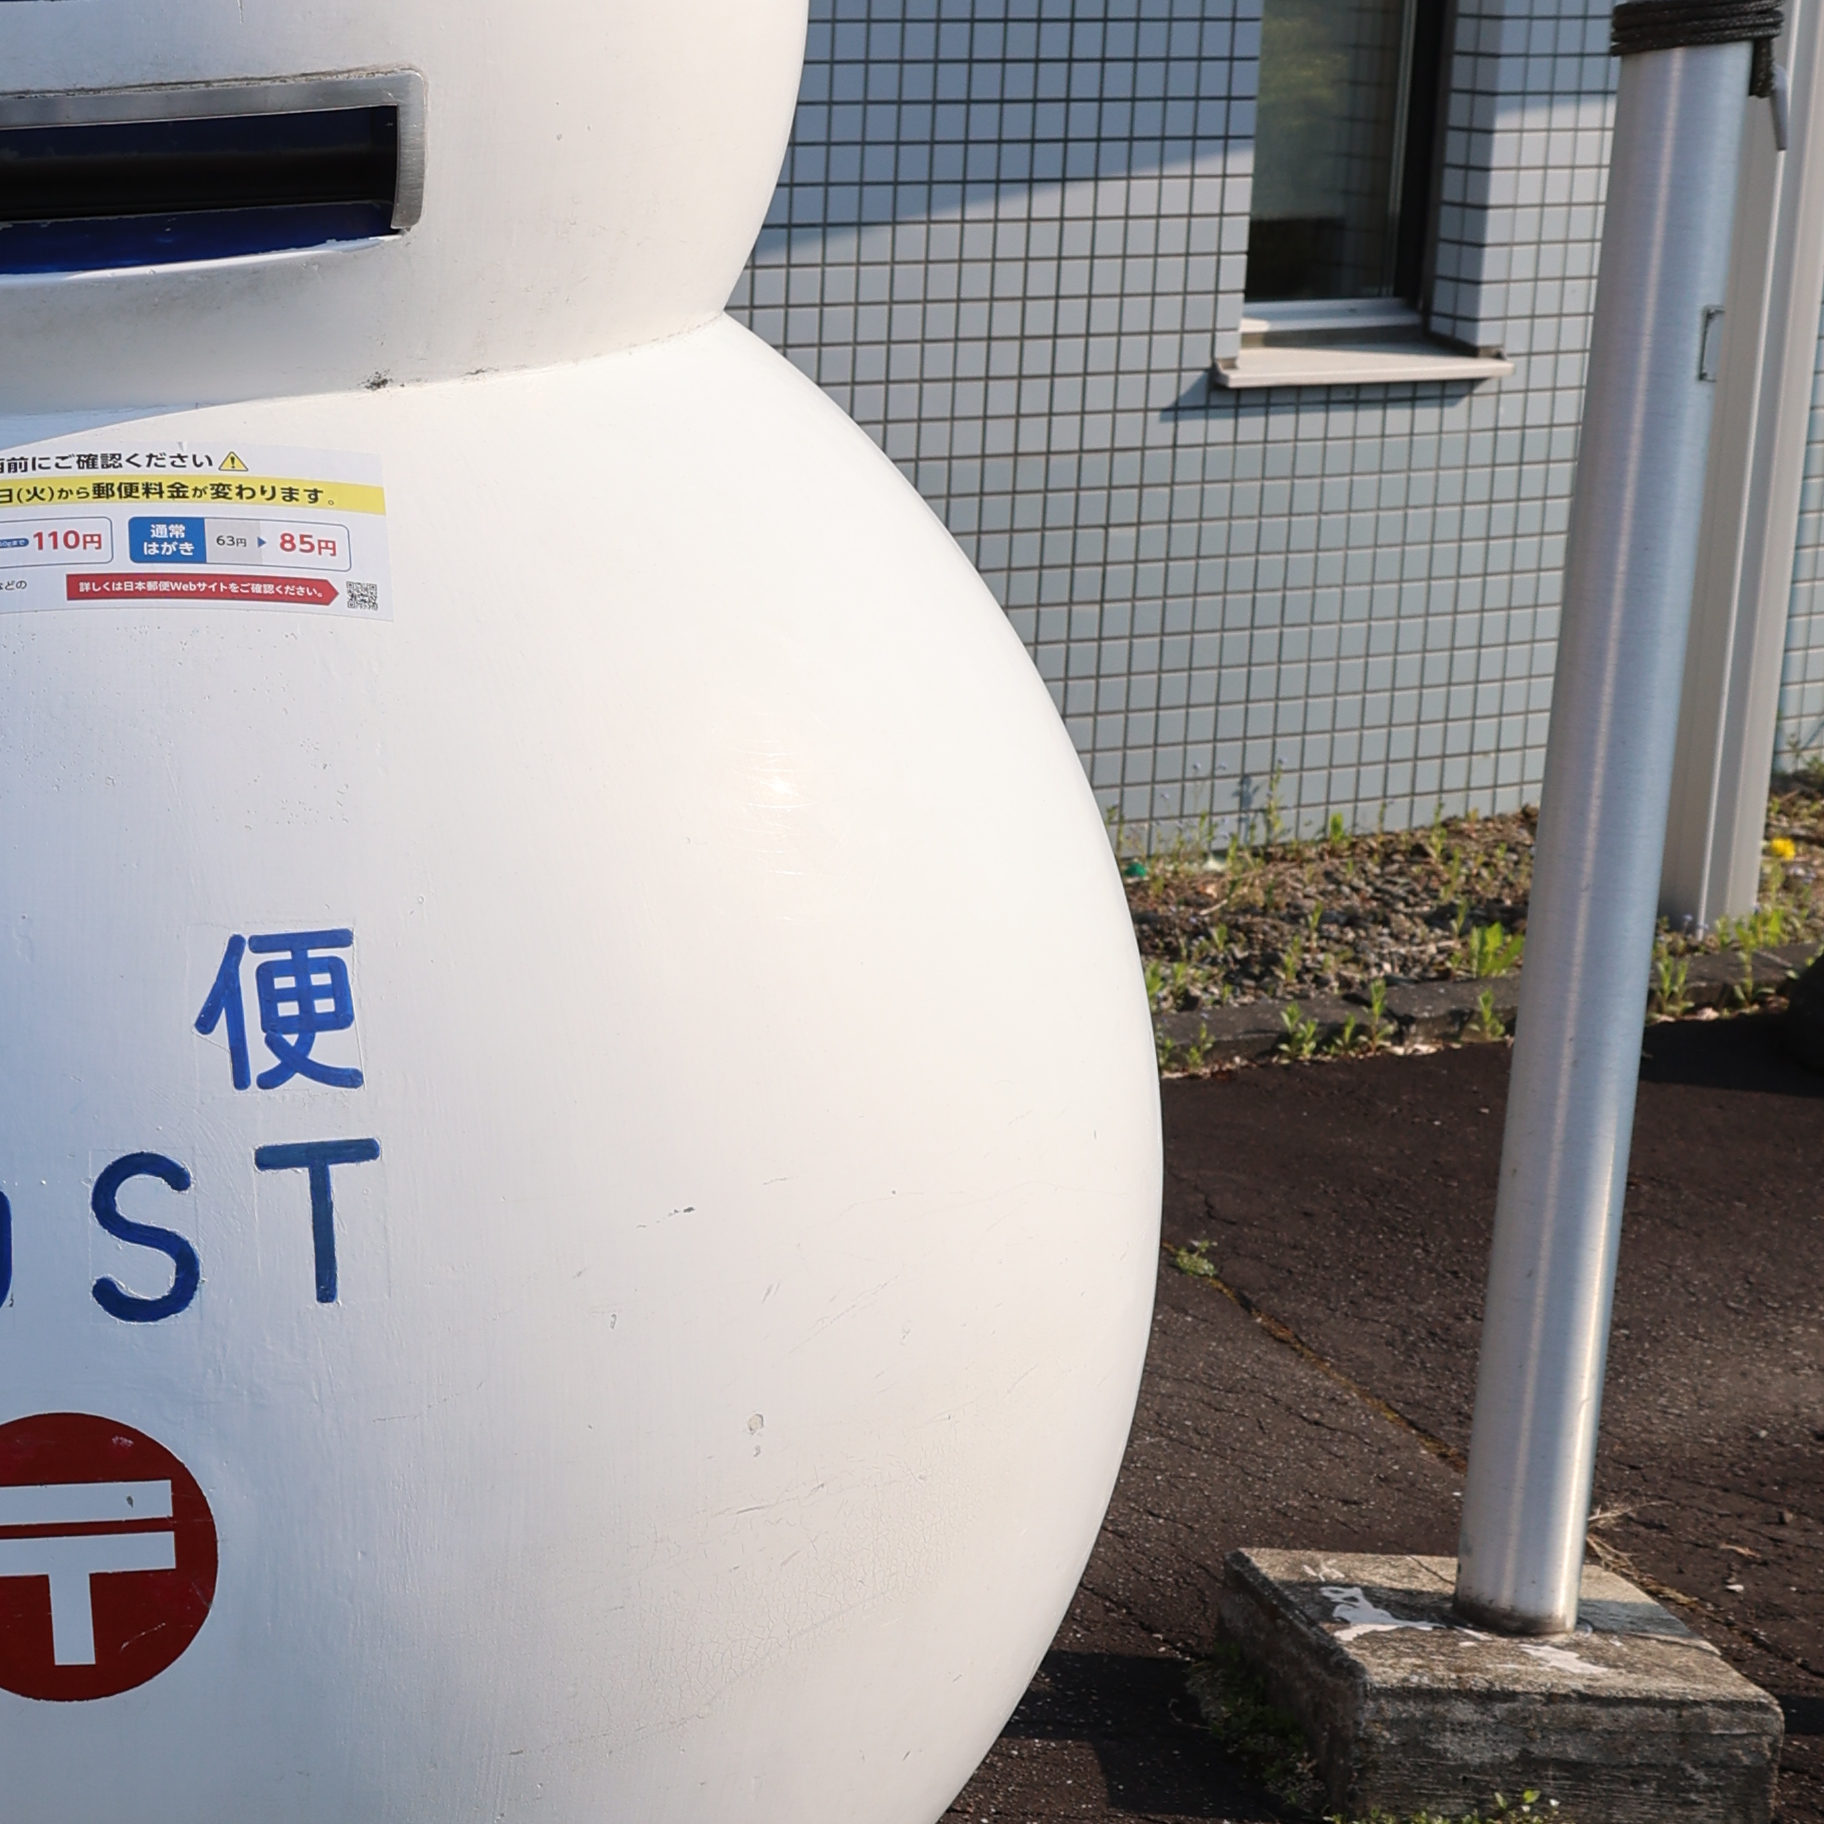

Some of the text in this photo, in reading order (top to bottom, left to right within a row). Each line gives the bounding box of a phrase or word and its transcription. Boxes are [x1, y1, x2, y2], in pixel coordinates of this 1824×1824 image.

[33, 530, 103, 551] 110円
[150, 524, 186, 539] 通常
[143, 541, 194, 556] はがき
[216, 532, 337, 557] 63円 85円
